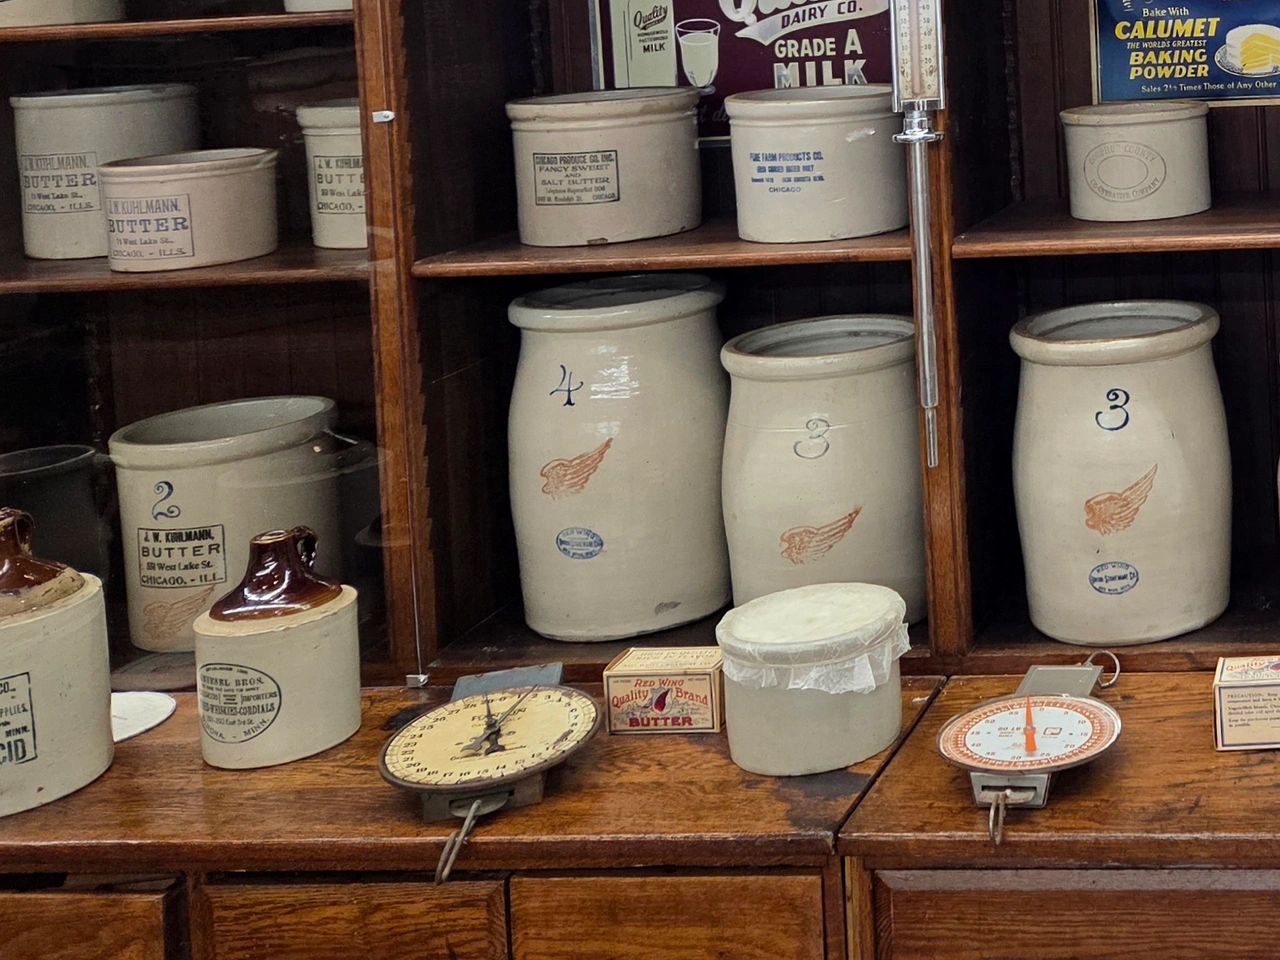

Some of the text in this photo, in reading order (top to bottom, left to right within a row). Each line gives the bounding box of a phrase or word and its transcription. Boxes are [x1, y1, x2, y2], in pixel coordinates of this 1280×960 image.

[634, 5, 669, 29] Quality
[780, 0, 864, 29] DAIRY CO.
[1142, 7, 1190, 17] Bake With
[1114, 17, 1221, 40] CALUMET
[642, 42, 667, 54] MILK
[774, 29, 863, 58] GRADE A
[1172, 39, 1207, 47] GREATEST
[1129, 49, 1208, 65] BAKING
[774, 59, 869, 88] MILK
[1129, 64, 1210, 80] POWDER
[1141, 85, 1161, 93] Sales
[1179, 83, 1201, 91] Times
[1203, 82, 1225, 90] Those
[1236, 81, 1253, 91] Any
[1255, 80, 1277, 88] Other
[23, 173, 97, 189] BUTTER
[108, 216, 189, 233] BUTTER
[549, 364, 584, 406] 4
[1095, 387, 1131, 432] 3
[793, 417, 830, 460] 3
[152, 481, 181, 520] 2
[141, 543, 220, 559] BUTTER
[178, 561, 199, 571] Lake
[634, 677, 685, 688] RED WING
[612, 687, 708, 708] Quality Brand
[628, 716, 694, 728] BUTTER
[5, 725, 30, 738] MINN.
